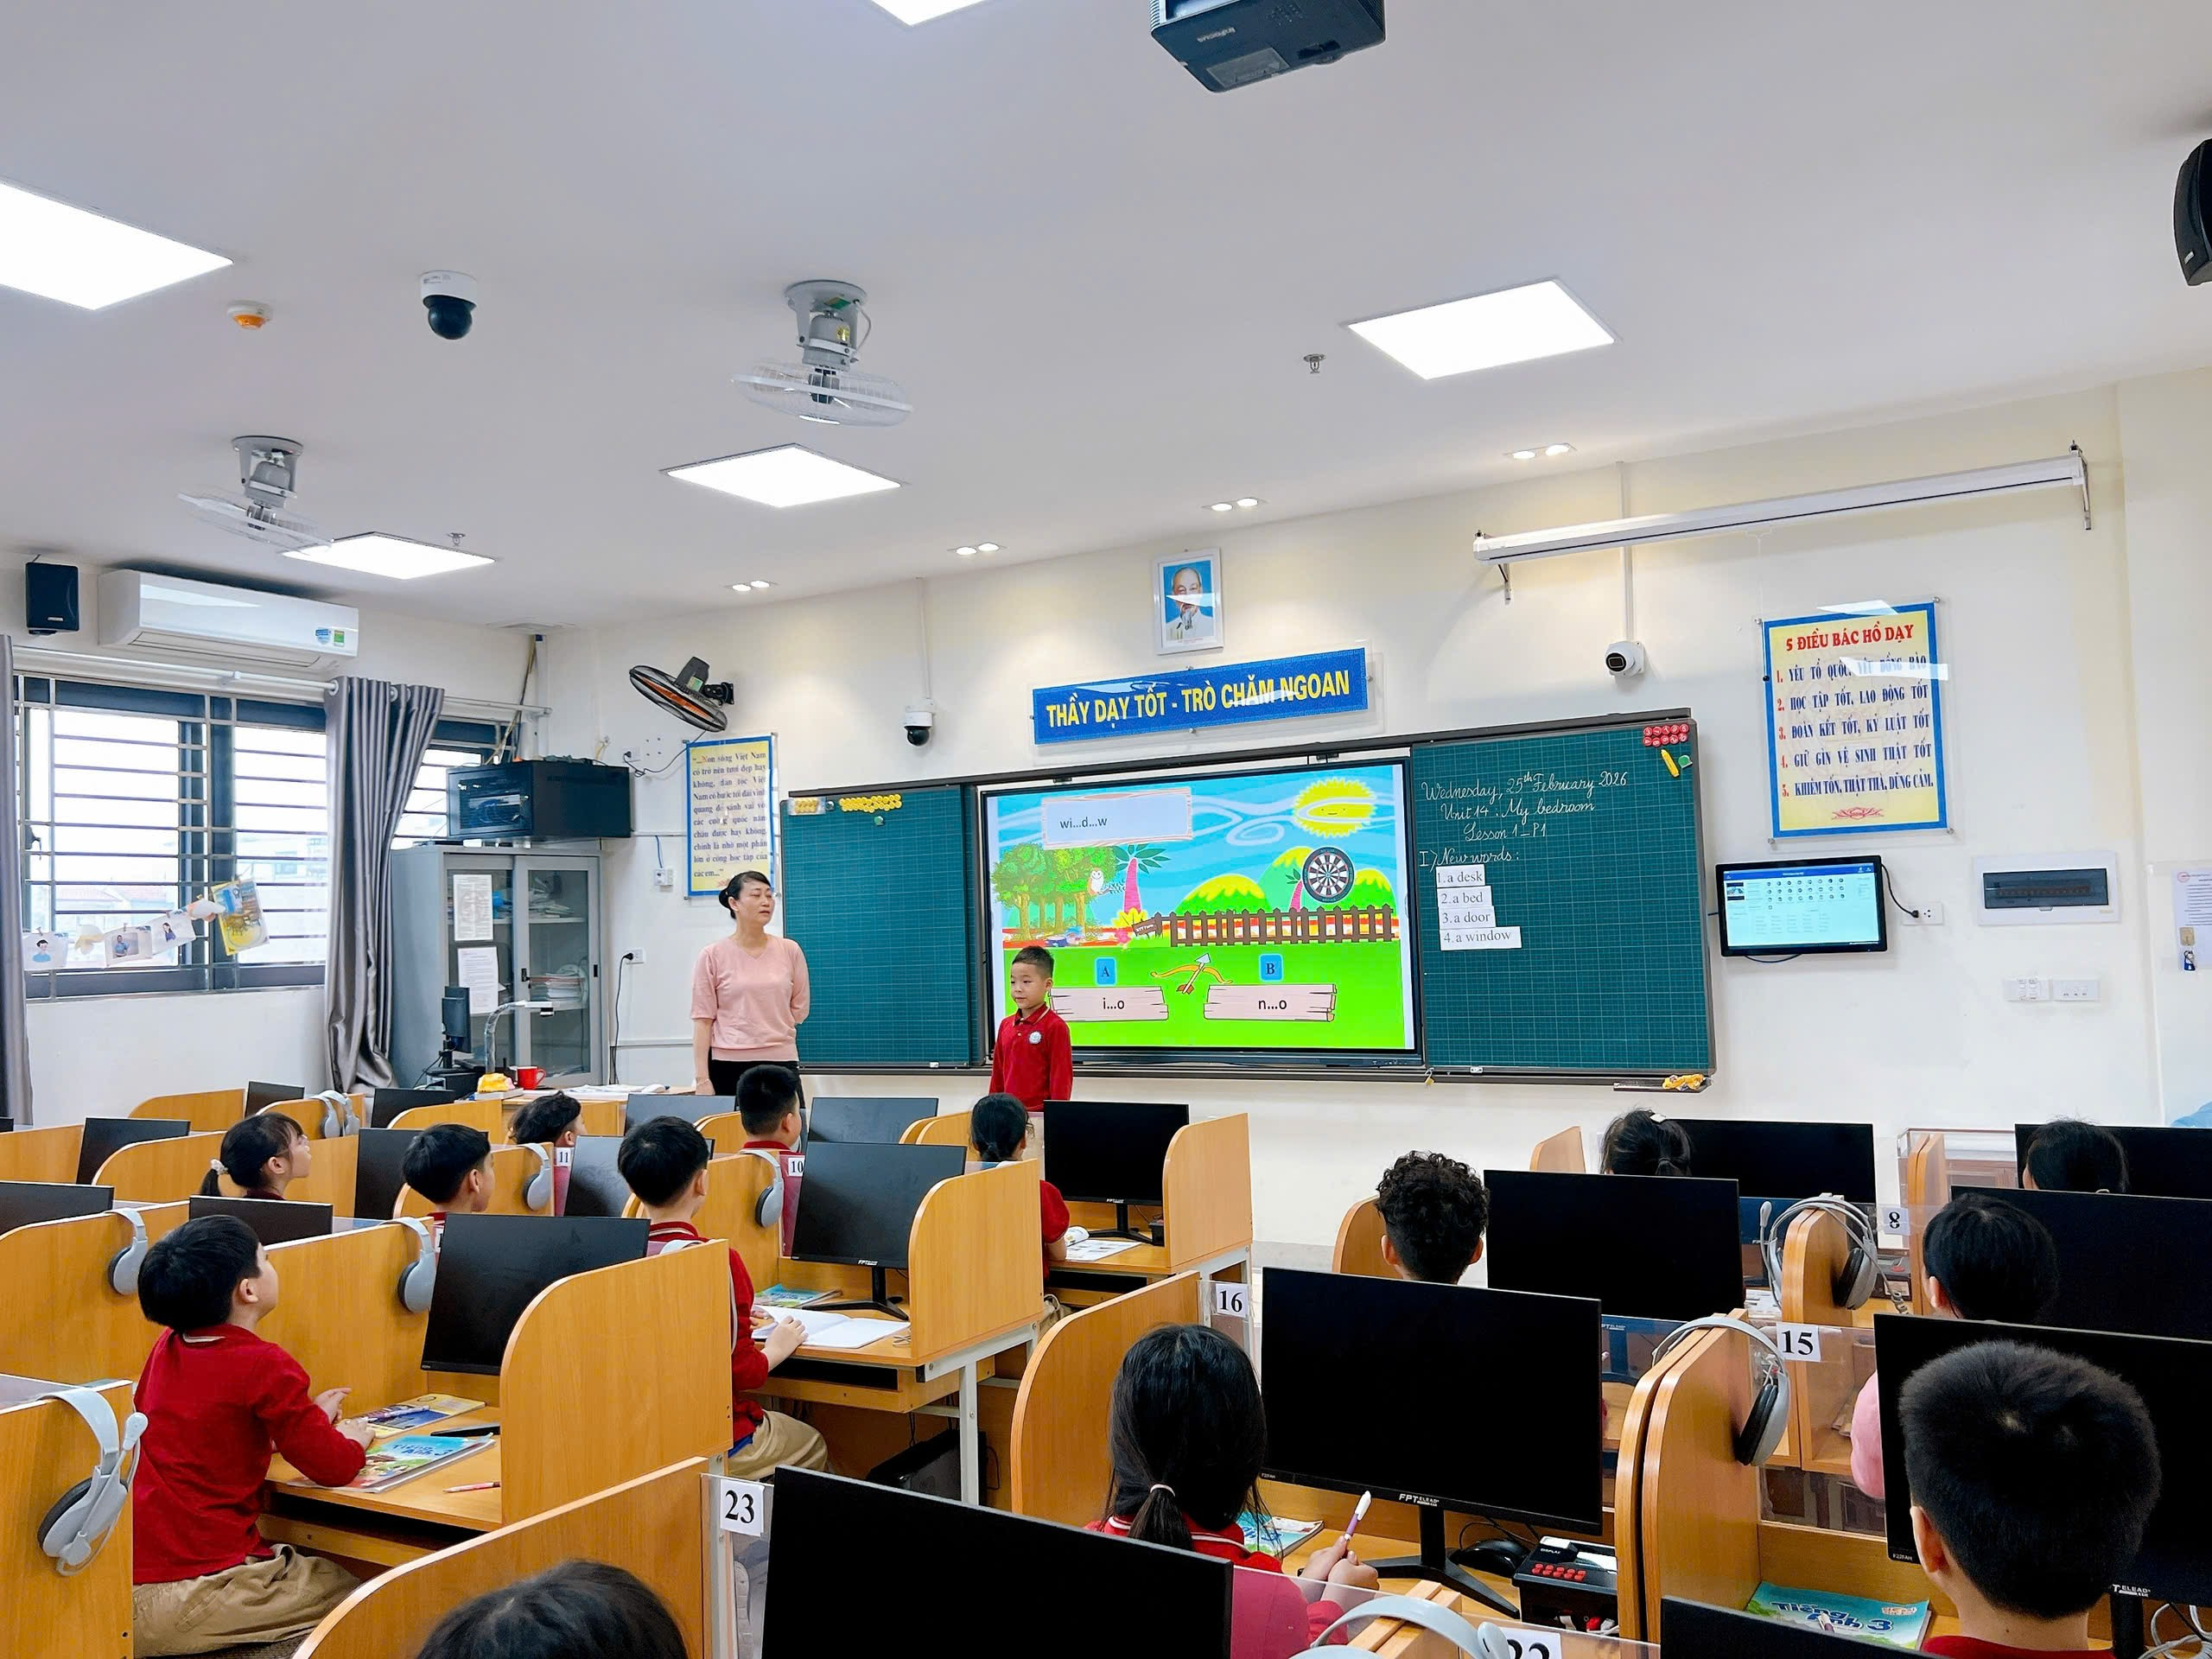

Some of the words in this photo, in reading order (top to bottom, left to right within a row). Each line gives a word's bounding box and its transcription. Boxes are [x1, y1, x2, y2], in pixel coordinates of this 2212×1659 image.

[1786, 639, 1793, 652] 5
[1797, 627, 1828, 650] ĐIỀU
[1833, 628, 1859, 646] BÁC
[1863, 621, 1882, 643] HỒ
[1885, 624, 1914, 644] DẠY
[1777, 670, 1783, 683] 1.
[1789, 664, 1805, 682] YÊU
[1810, 658, 1821, 679] TỔ
[1046, 692, 1090, 728] THẦY
[1095, 696, 1129, 728] DẠY
[1135, 682, 1167, 718] TỐT
[1181, 680, 1217, 713] TRÒ
[1221, 674, 1274, 709] CHĂM
[1280, 670, 1350, 702] NGOAN
[1777, 698, 1785, 712] 2.
[1790, 696, 1807, 715] HỌC
[1812, 691, 1828, 713] TẬP
[1859, 690, 1876, 704] LAO
[1882, 684, 1904, 706] ĐỘNG
[1911, 678, 1929, 700] TỐT
[1779, 727, 1786, 740] 3.
[1791, 721, 1813, 739] ĐOÀN
[1819, 715, 1835, 736] KẾT
[1866, 713, 1878, 733] KỶ
[1885, 713, 1906, 734] LUẬT
[1912, 708, 1929, 728] TỐT
[1780, 755, 1788, 768] 4.
[1794, 749, 1809, 767] GIỮ
[1815, 747, 1831, 766] GÌN
[1838, 747, 1849, 767] VỆ
[1855, 747, 1876, 763] SINH
[1883, 741, 1907, 764] THẬT
[1914, 737, 1932, 758] TỐT
[1421, 779, 1503, 804] Wednesday,
[1534, 772, 1594, 798] February
[1599, 772, 1628, 786] 2026
[1782, 784, 1789, 798] 5.
[1795, 778, 1823, 796] KHIÊM
[1843, 774, 1866, 797] THẬT
[1889, 772, 1910, 790] DŨNG
[1441, 803, 1471, 820] Unit
[1475, 804, 1489, 817] 14
[1501, 798, 1529, 823] My
[1536, 798, 1595, 814] bedroom
[1458, 871, 1484, 882] desk
[1463, 892, 1483, 903] bed
[1464, 912, 1491, 923] door
[1465, 930, 1512, 942] window
[1101, 967, 1110, 977] A
[1266, 963, 1275, 974] B
[559, 1151, 569, 1163] 11
[791, 1160, 804, 1173] 10
[1889, 1211, 1900, 1229] 8
[1219, 1290, 1243, 1313] 16
[1781, 1330, 1814, 1356] 15
[725, 1490, 754, 1524] 23
[1399, 1493, 1418, 1503] FPT
[1866, 1618, 1893, 1631] 3
